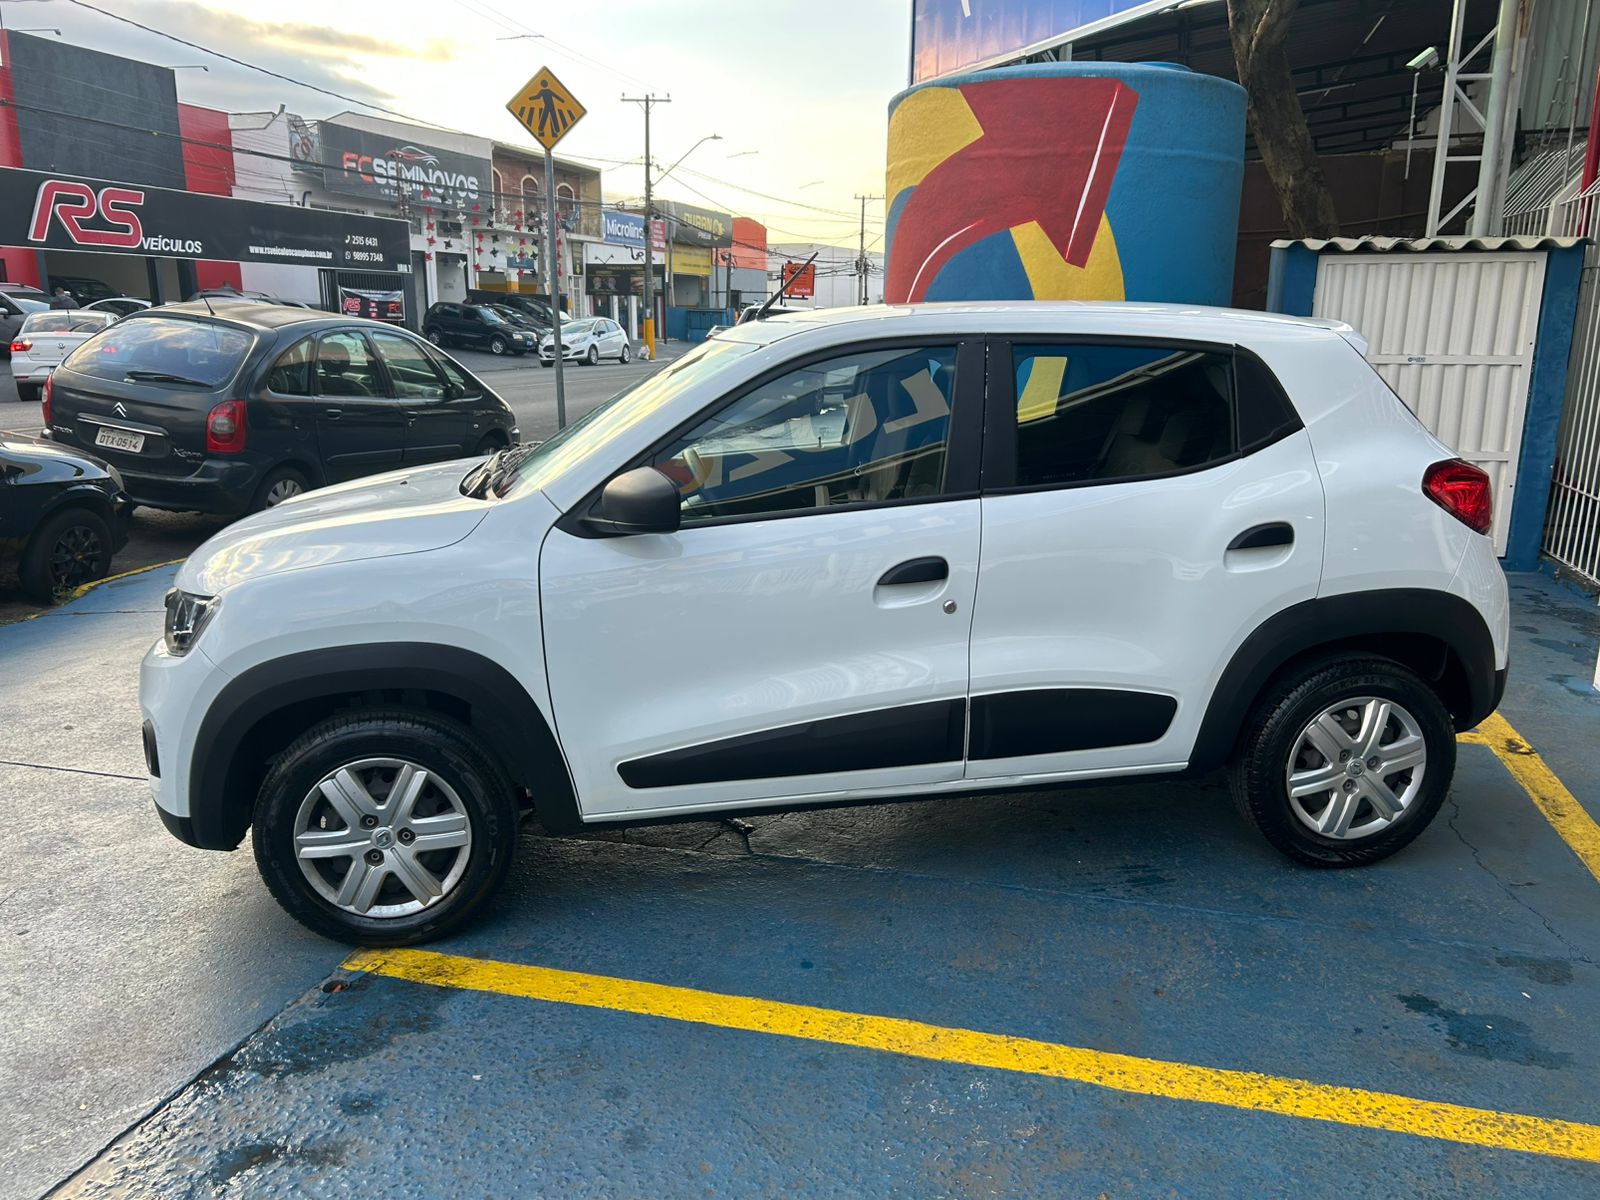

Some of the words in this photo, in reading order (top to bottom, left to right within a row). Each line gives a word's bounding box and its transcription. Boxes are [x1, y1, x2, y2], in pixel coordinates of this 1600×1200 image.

[28, 179, 145, 248] RS
[607, 218, 644, 239] Microlins
[142, 235, 202, 254] VEÍCULOS
[352, 235, 365, 245] 2515
[365, 237, 378, 247] 6431
[370, 252, 384, 262] 7348
[343, 297, 361, 312] RS
